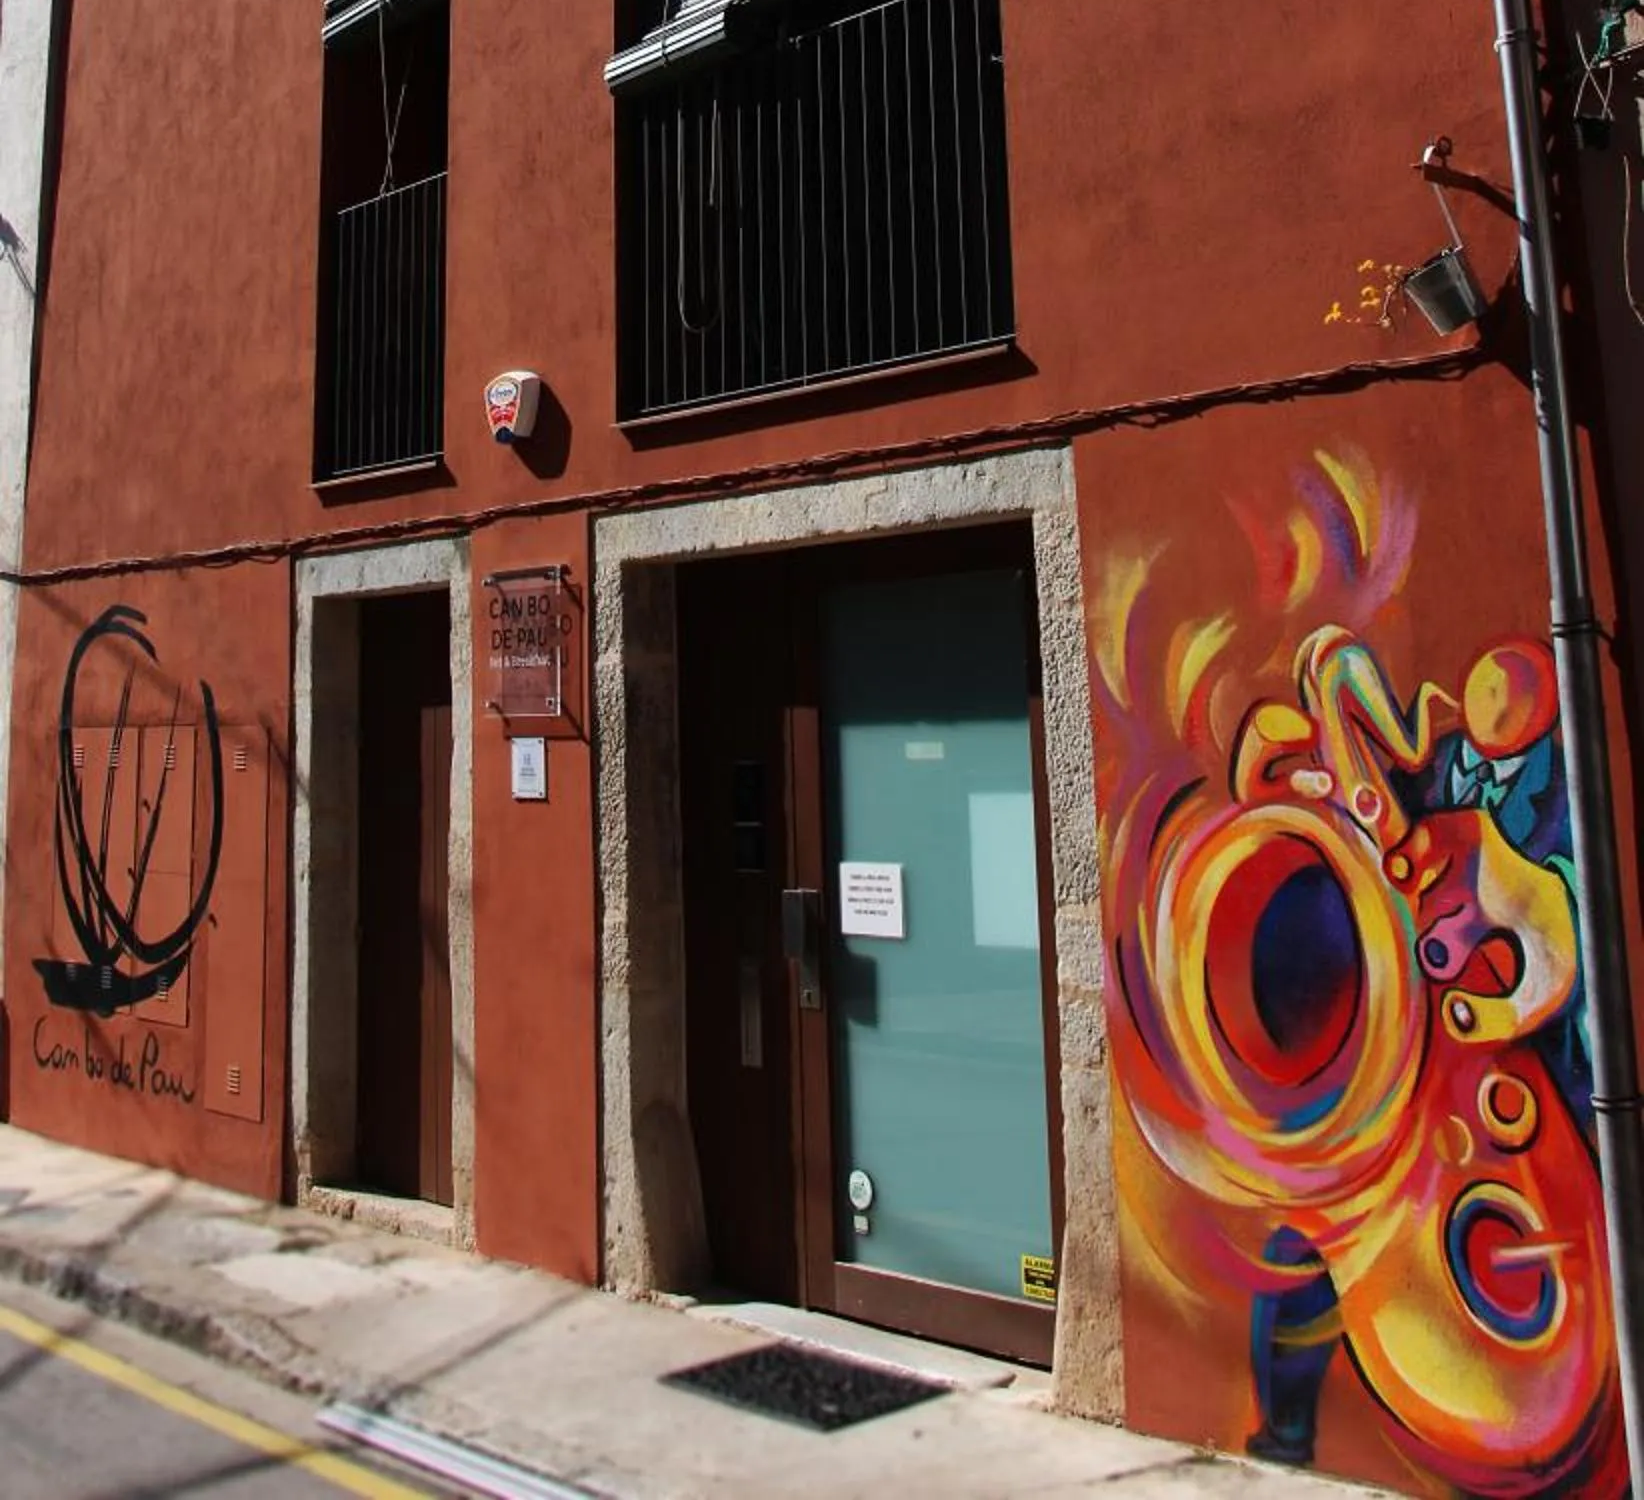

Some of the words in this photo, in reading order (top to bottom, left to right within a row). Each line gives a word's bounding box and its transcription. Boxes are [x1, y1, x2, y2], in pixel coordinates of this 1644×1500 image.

[489, 596, 522, 620] CAN
[527, 594, 551, 617] BO
[491, 628, 513, 650] DE
[517, 627, 547, 649] PAU
[110, 1034, 135, 1090] de
[139, 1031, 196, 1104] Pau
